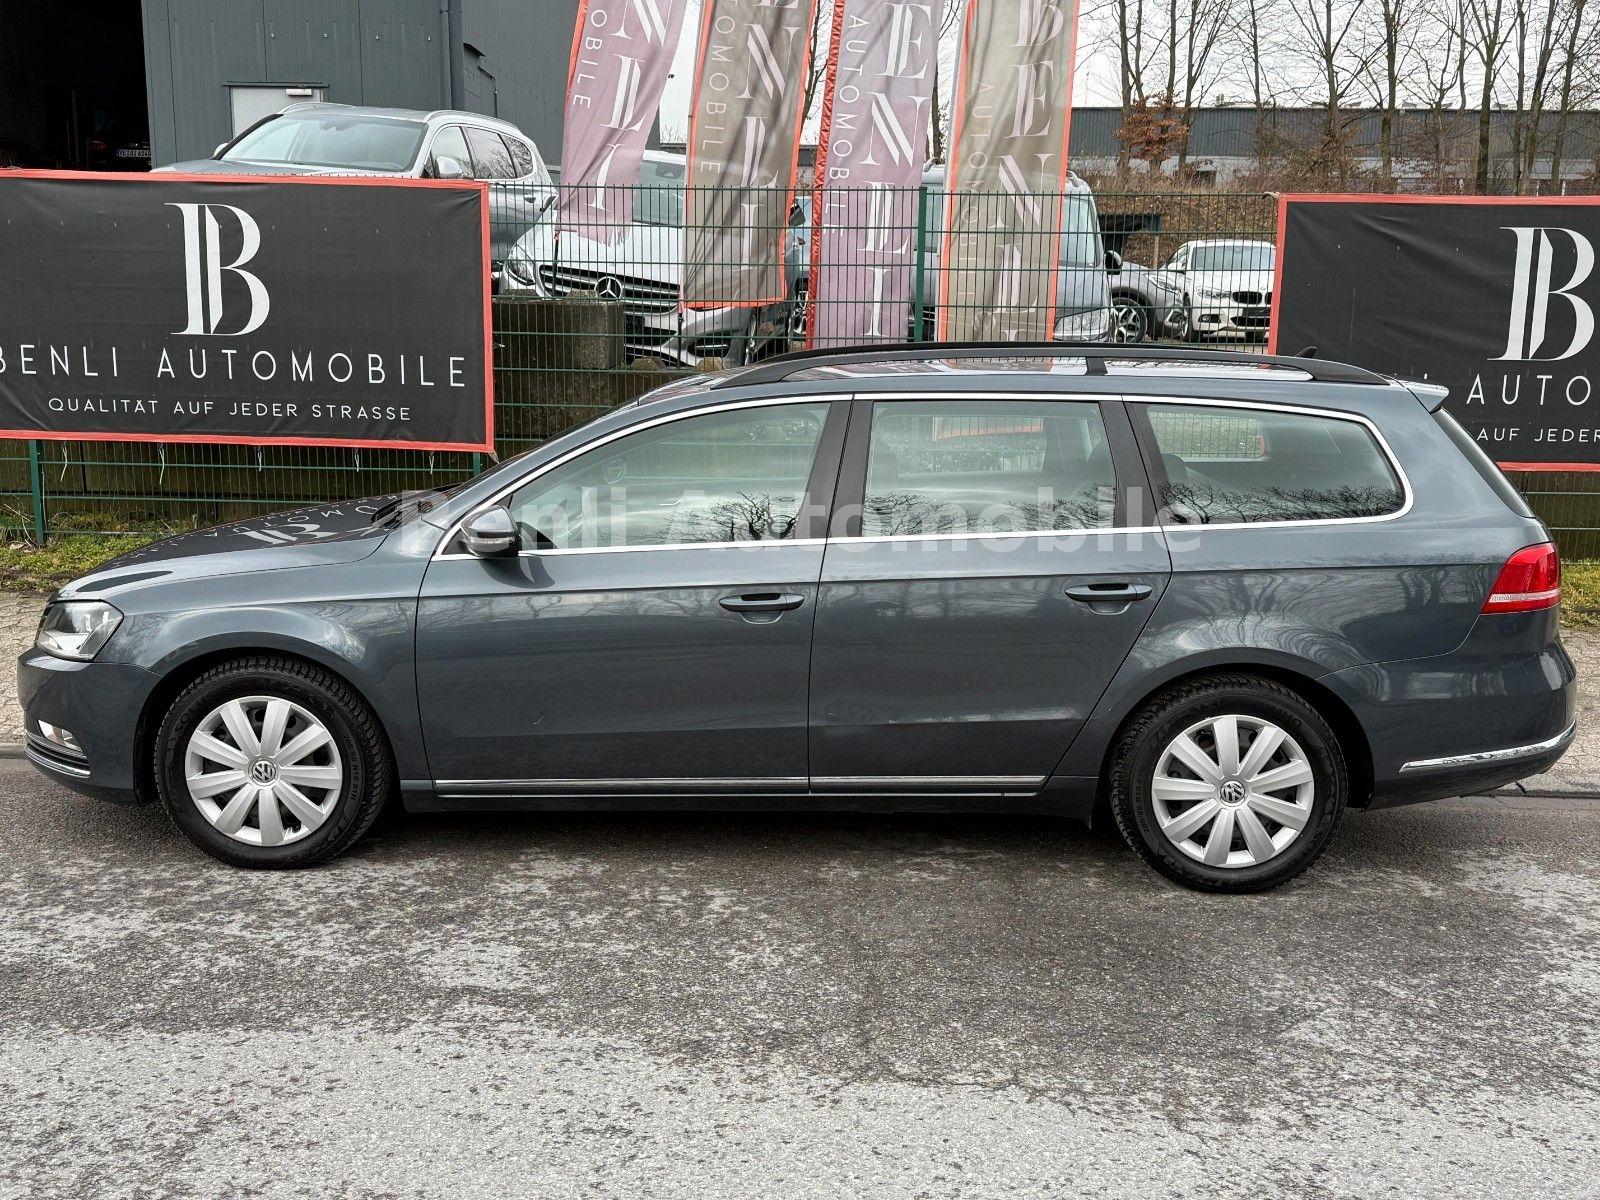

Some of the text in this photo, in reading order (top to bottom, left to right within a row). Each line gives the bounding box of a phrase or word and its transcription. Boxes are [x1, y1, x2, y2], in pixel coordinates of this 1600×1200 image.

[700, 0, 738, 174] OMOBILE
[733, 0, 803, 271] NLI
[822, 14, 870, 237] AUTOMOBILE
[988, 0, 1064, 341] BENL
[164, 202, 270, 336] B
[1487, 226, 1595, 361] B
[48, 397, 410, 421] QUALITÄT AUF JEDER STRASSE
[157, 348, 466, 387] AUTOMOBILE
[1466, 373, 1592, 406] AUTO
[1477, 428, 1520, 442] AUF
